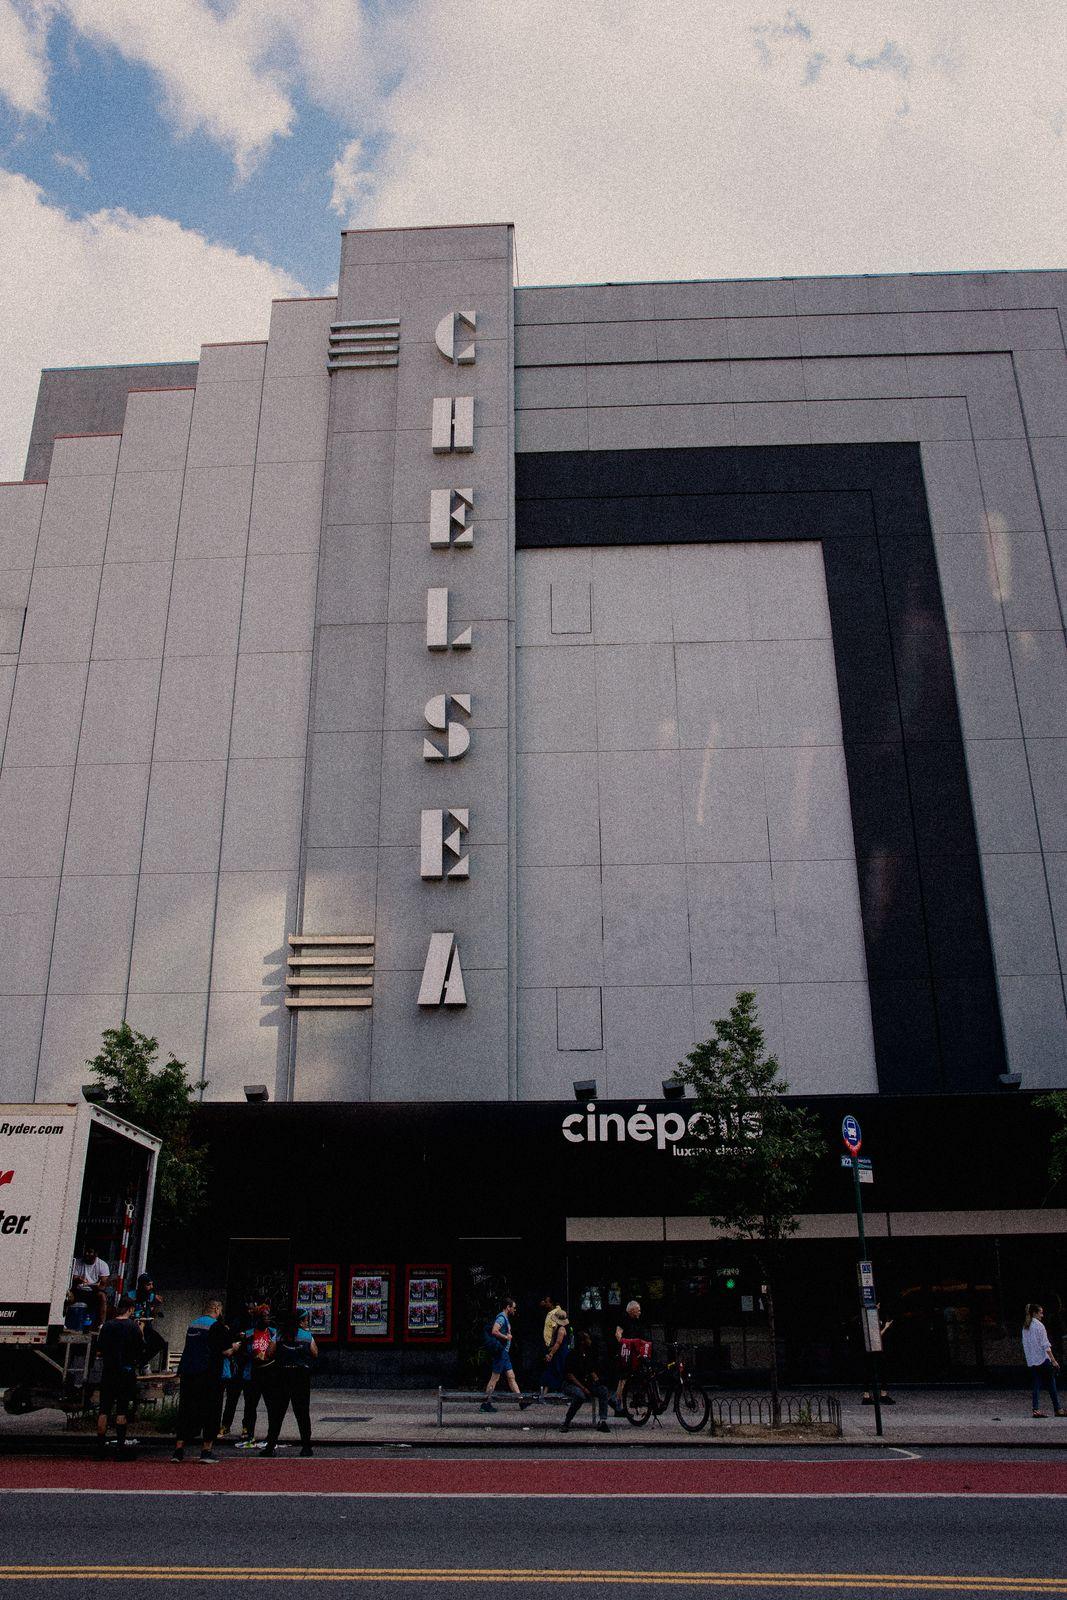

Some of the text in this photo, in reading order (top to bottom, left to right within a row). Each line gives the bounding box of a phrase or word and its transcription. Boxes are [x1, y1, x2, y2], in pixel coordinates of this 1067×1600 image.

[417, 310, 477, 1008] CHELSEA
[0, 1123, 64, 1136] Ryder.com
[672, 1144, 712, 1159] lux
